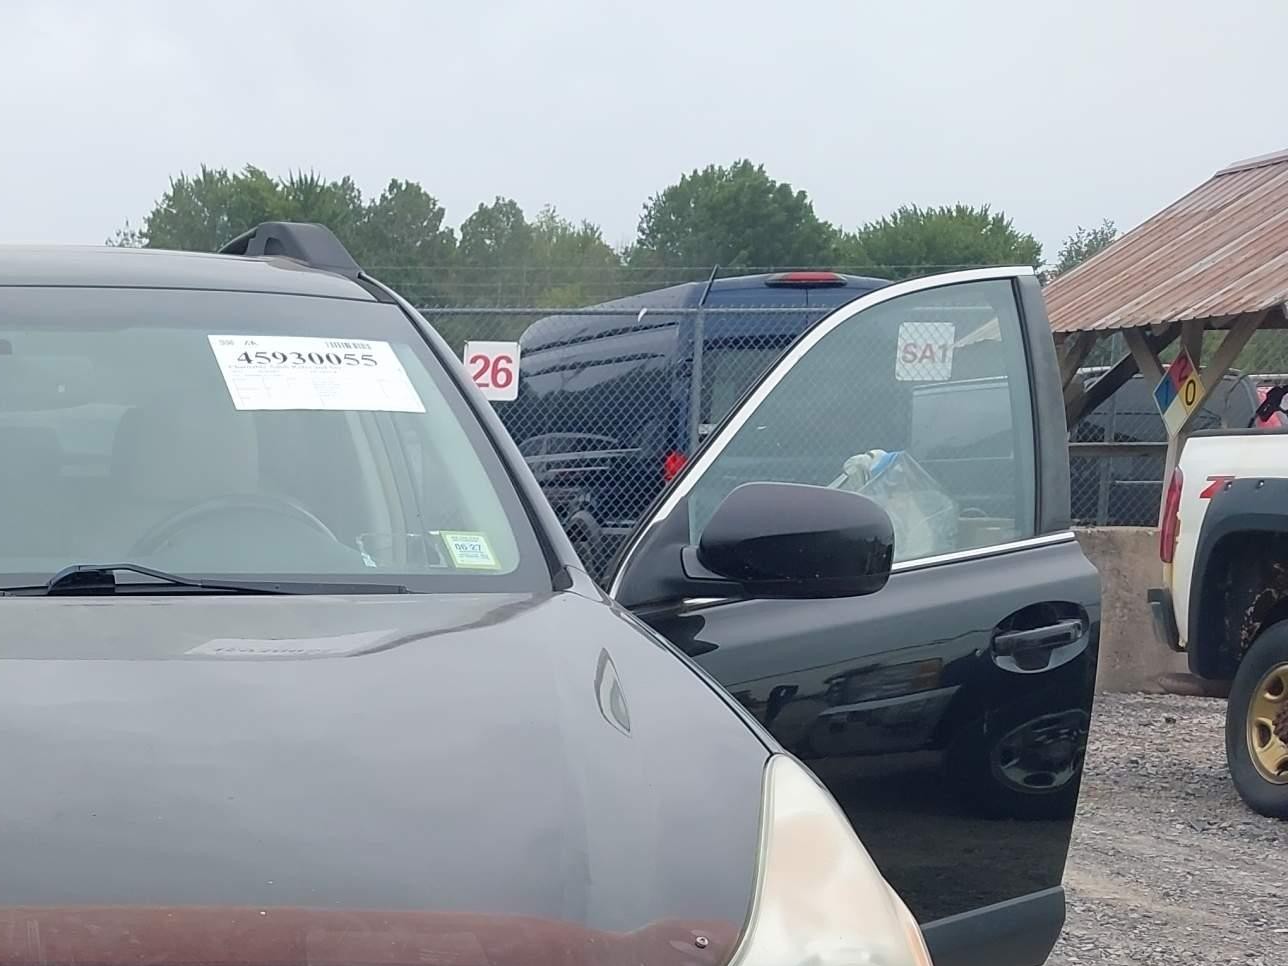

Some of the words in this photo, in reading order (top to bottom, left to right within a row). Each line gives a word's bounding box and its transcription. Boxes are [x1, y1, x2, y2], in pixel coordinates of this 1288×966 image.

[237, 351, 379, 367] 45930055
[469, 354, 513, 388] 26
[1185, 379, 1196, 406] 0
